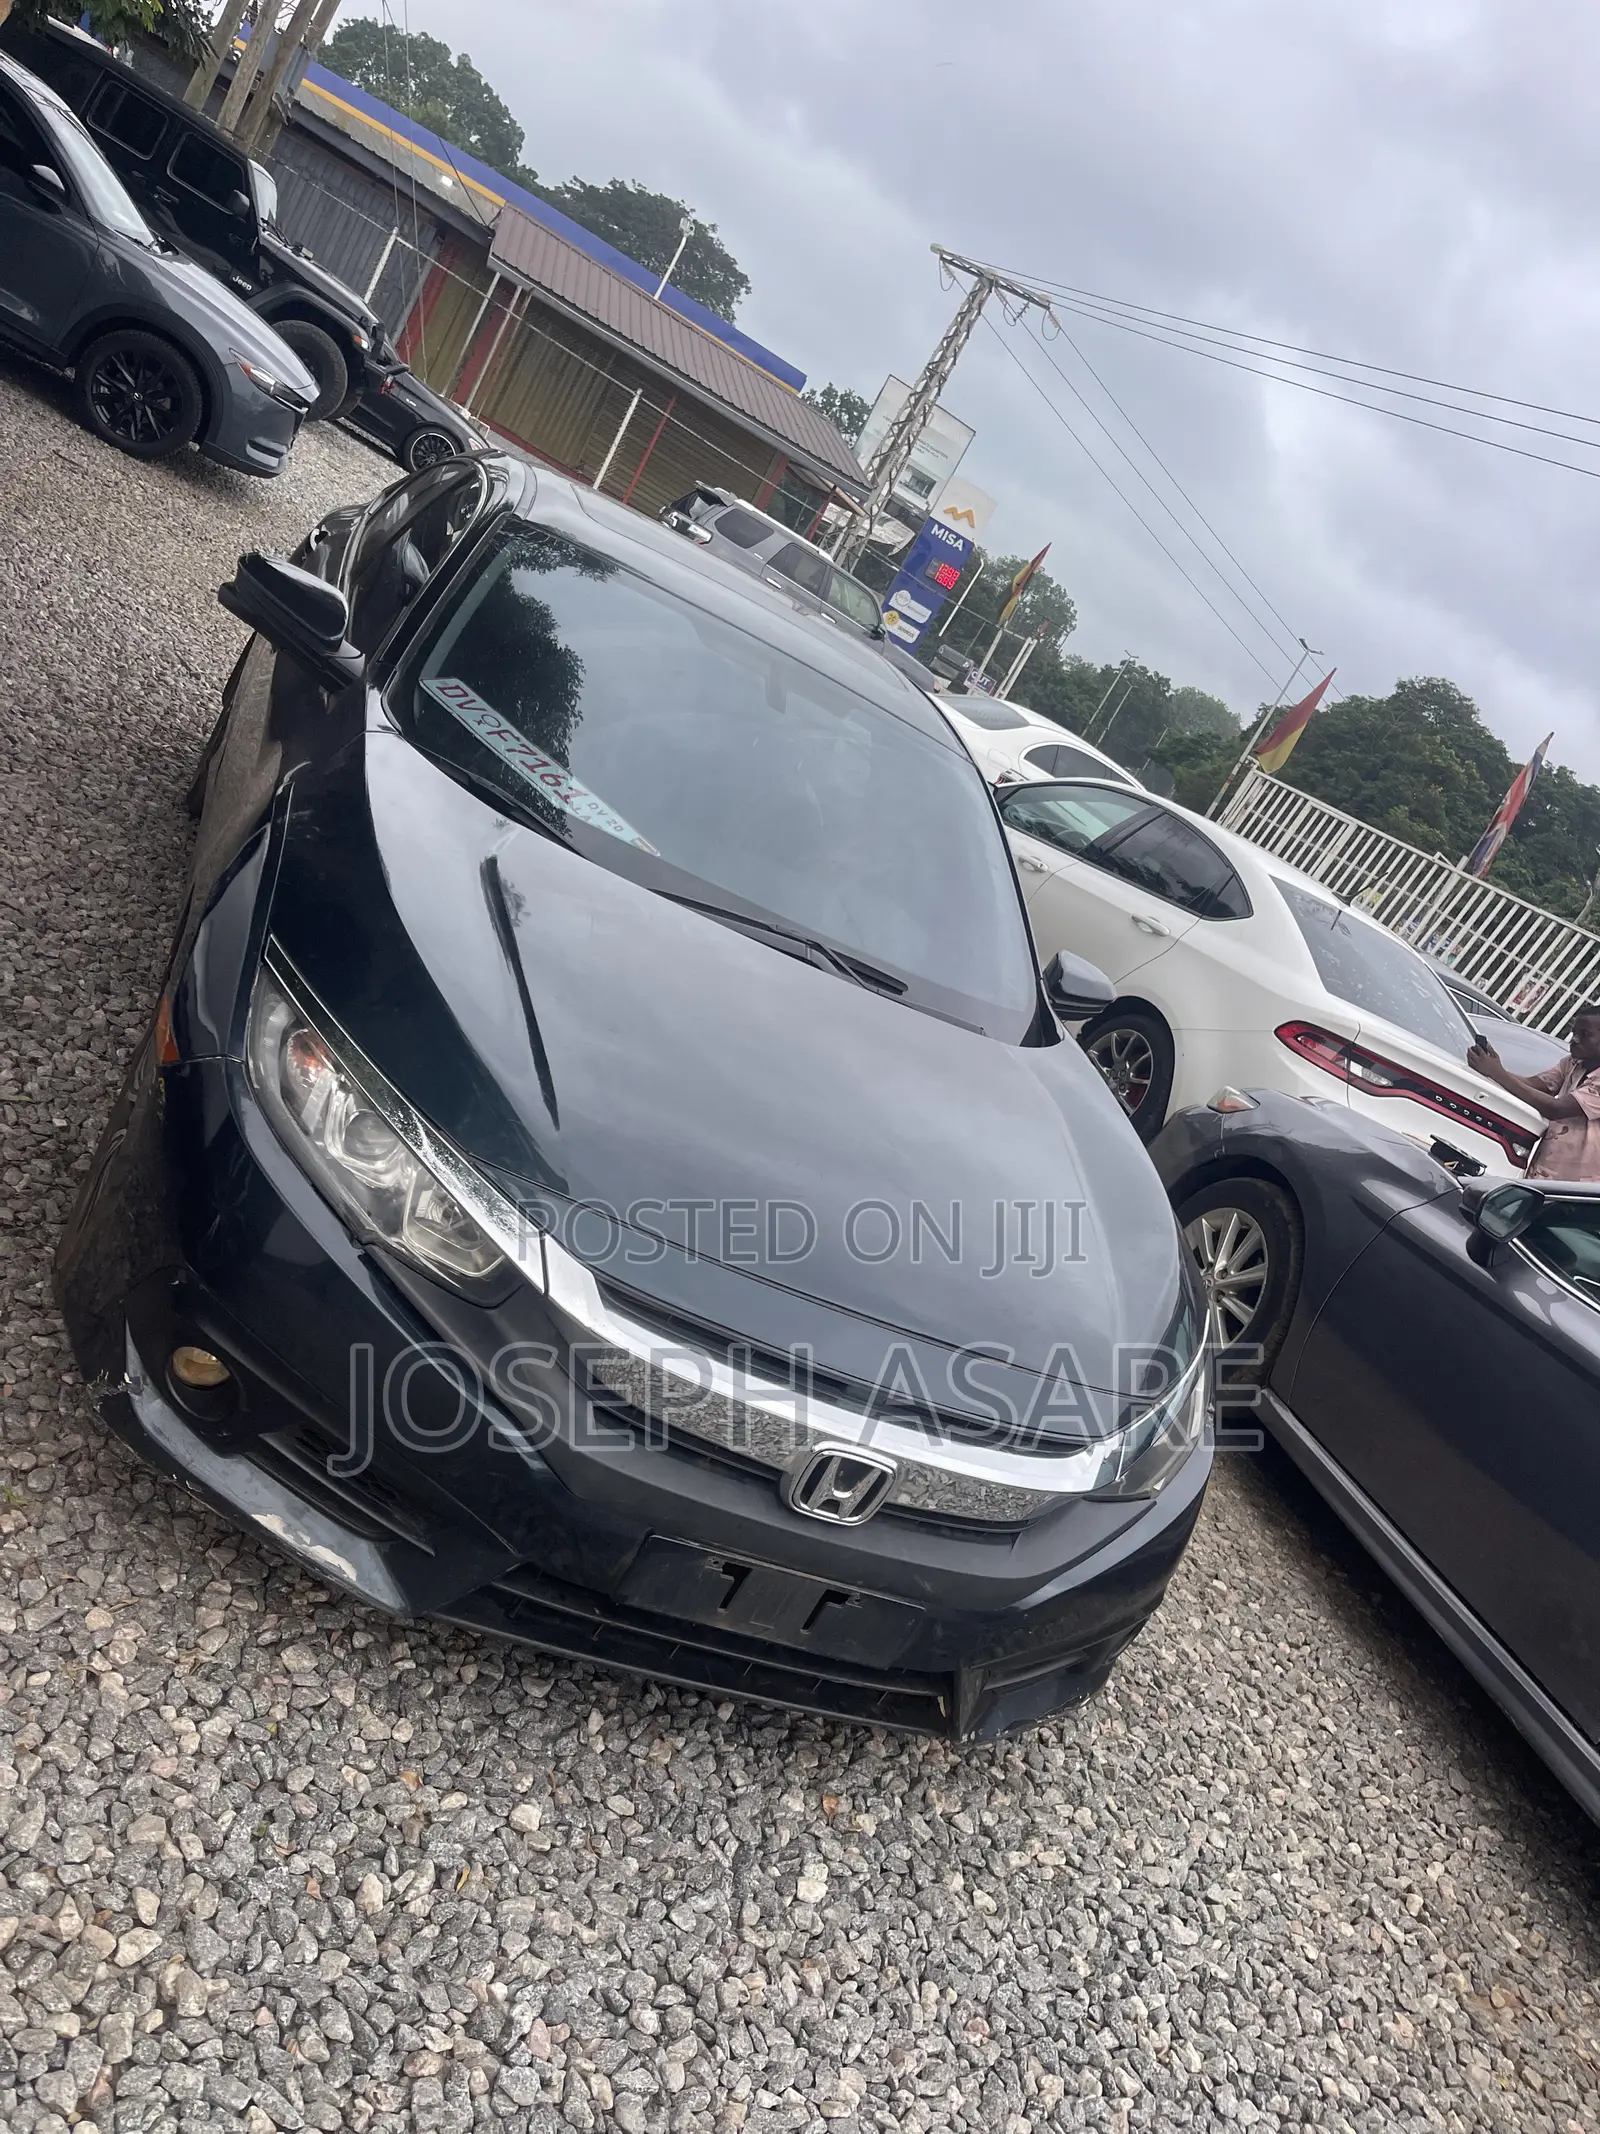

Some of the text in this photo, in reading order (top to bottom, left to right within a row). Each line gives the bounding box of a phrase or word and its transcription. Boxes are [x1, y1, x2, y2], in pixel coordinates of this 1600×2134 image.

[232, 275, 252, 291] Jeep
[931, 523, 964, 552] MISA
[436, 684, 488, 712] DV
